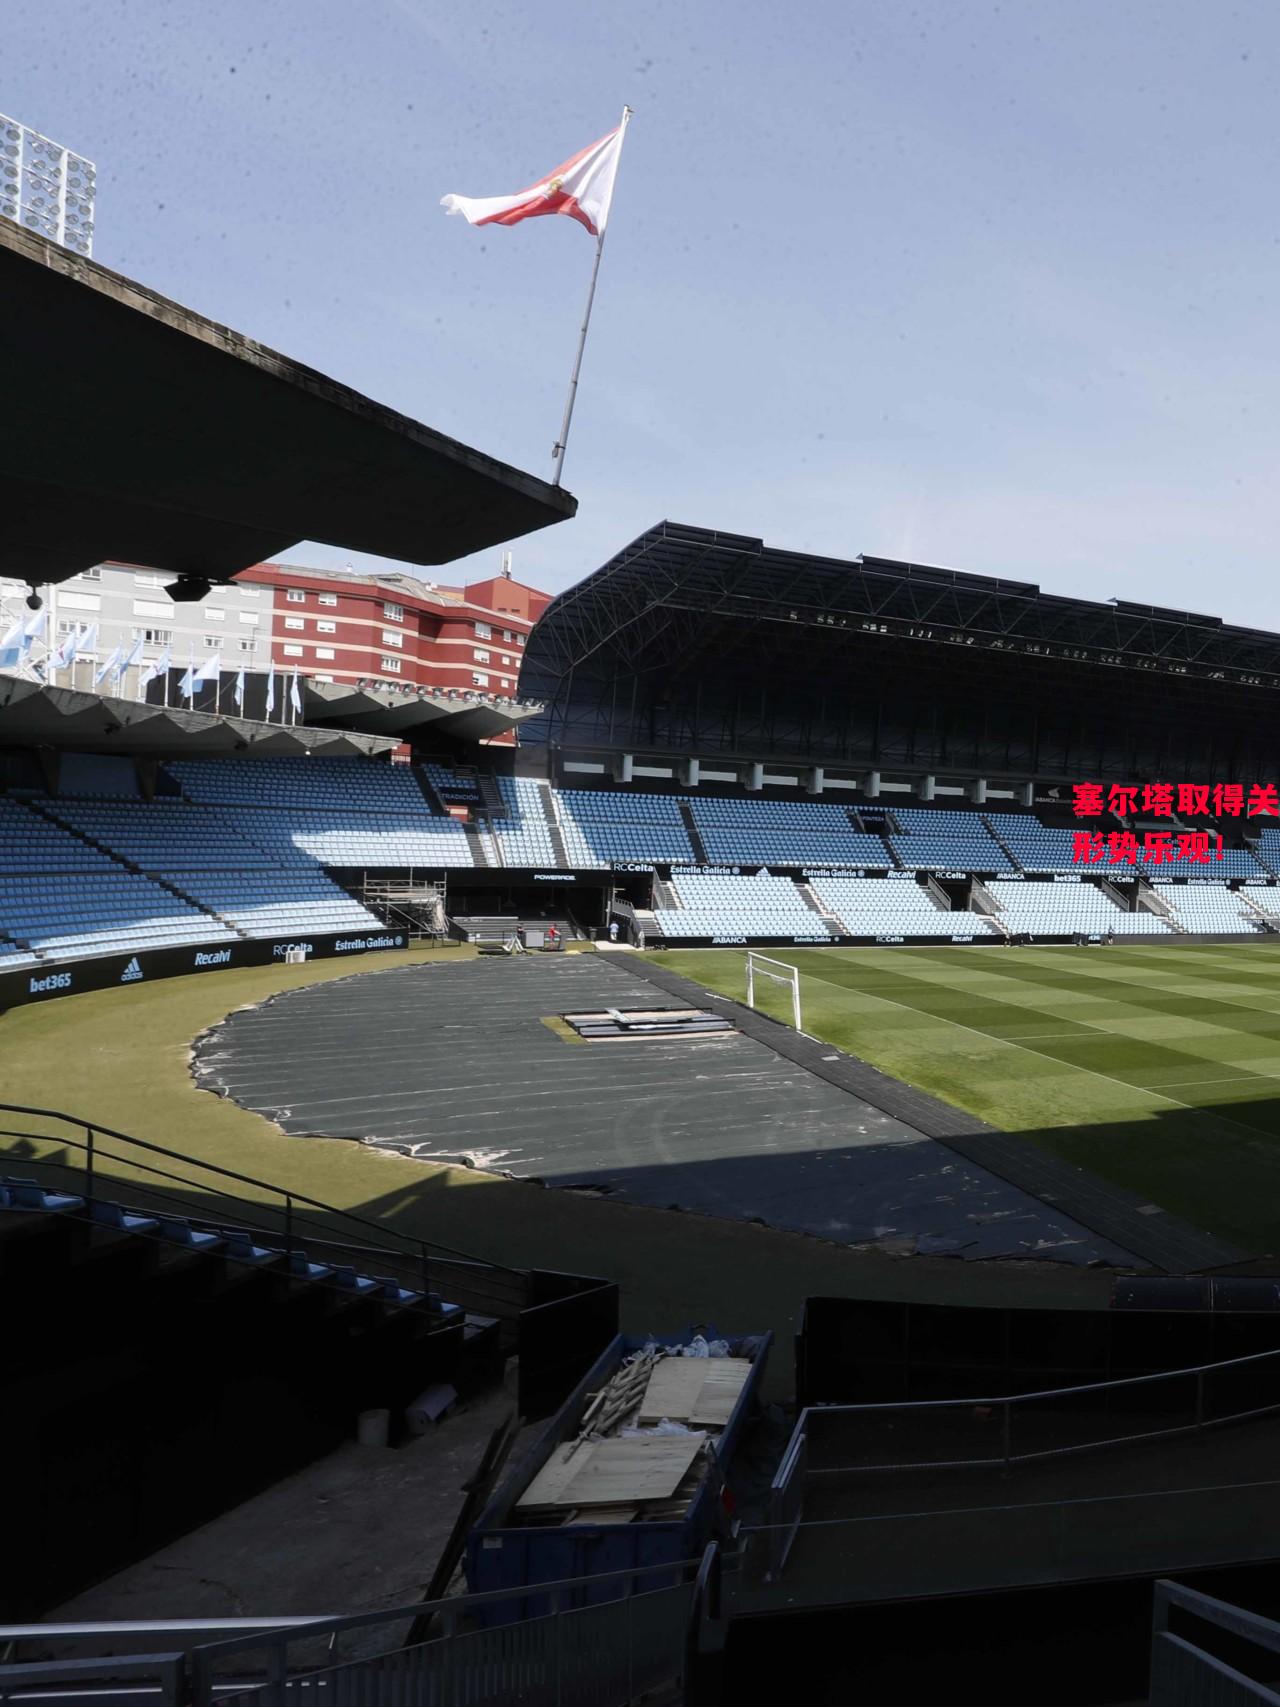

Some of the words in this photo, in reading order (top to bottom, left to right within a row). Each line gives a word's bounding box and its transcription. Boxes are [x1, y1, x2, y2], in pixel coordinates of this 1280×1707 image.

[670, 865, 701, 875] Estrella
[702, 865, 731, 875] Galicia
[802, 868, 831, 877] Estrella
[832, 869, 857, 878] Galicia
[887, 870, 917, 879] Recalvi
[1054, 874, 1081, 882] bet365
[335, 938, 365, 951] Estrella
[366, 936, 393, 949] Galicia
[712, 936, 747, 944] ABANCA
[195, 949, 231, 966] Recalvi
[30, 972, 72, 993] bet365
